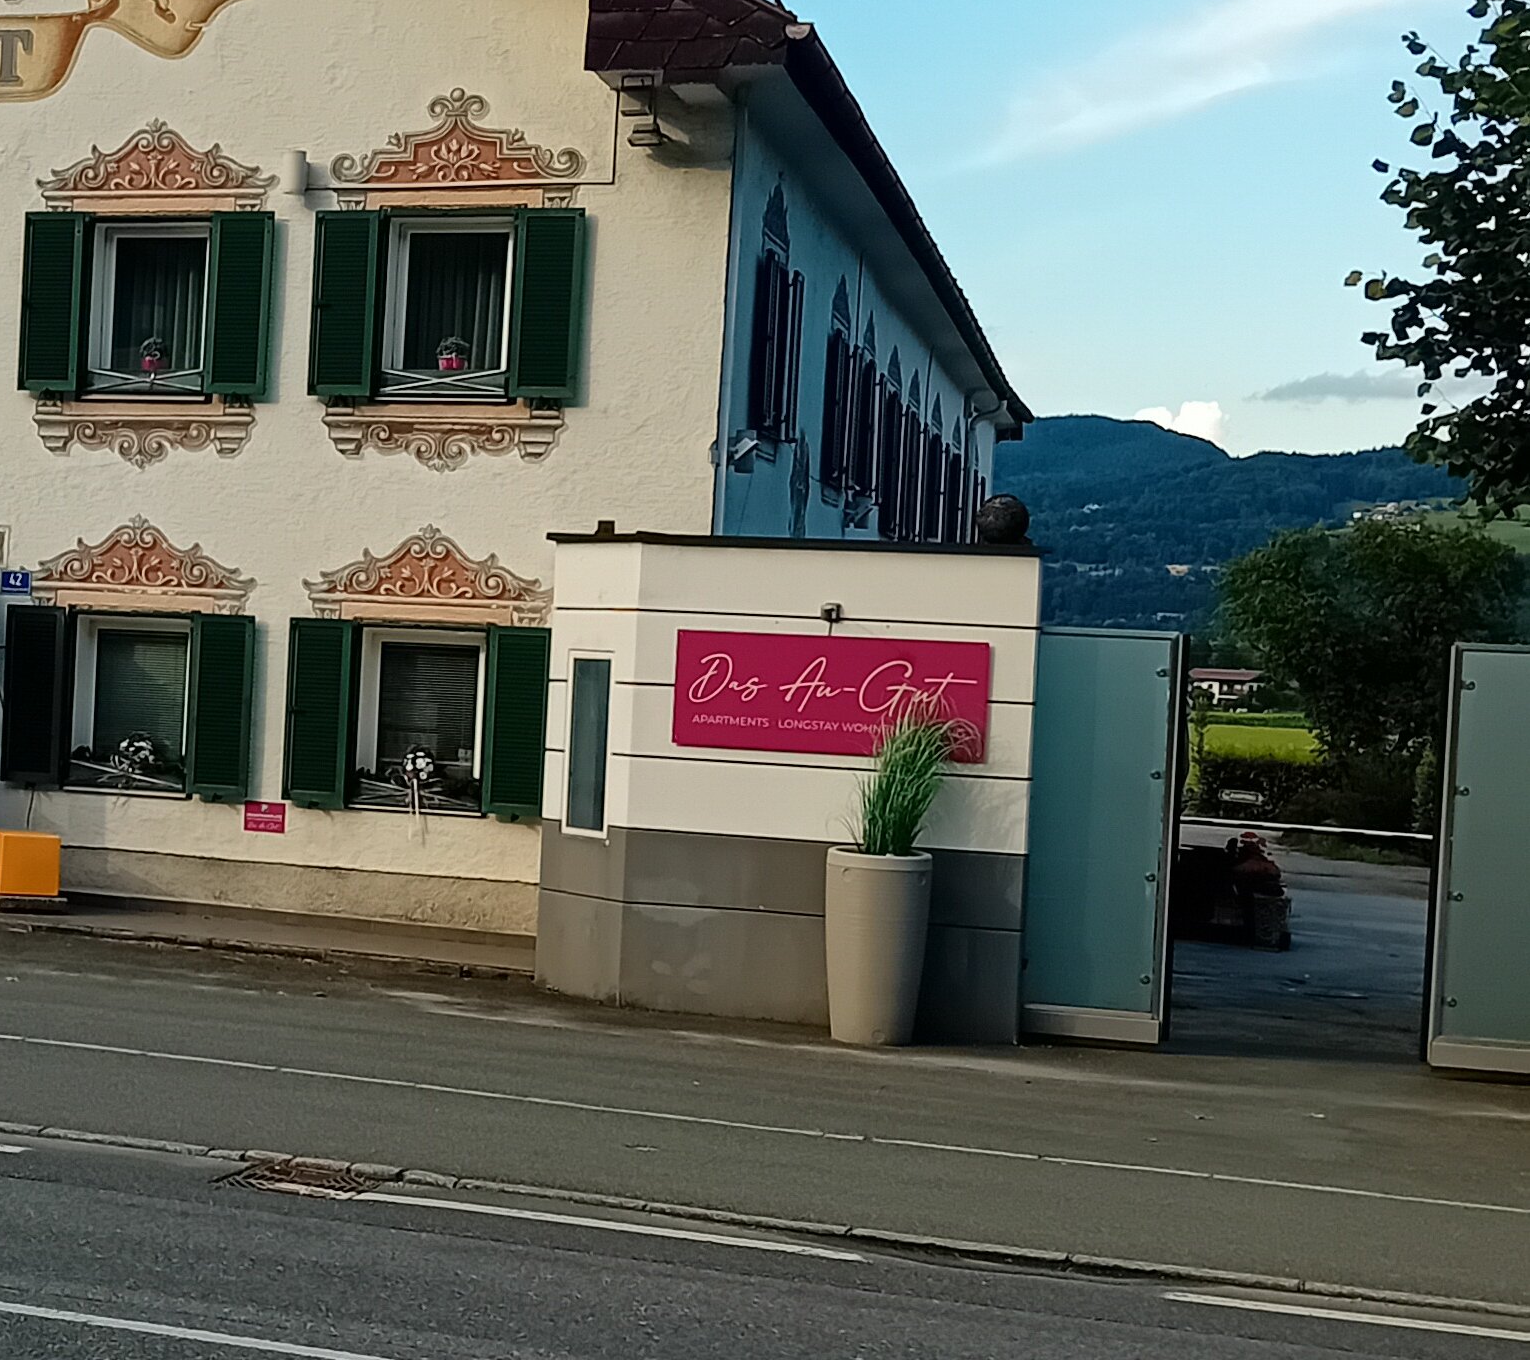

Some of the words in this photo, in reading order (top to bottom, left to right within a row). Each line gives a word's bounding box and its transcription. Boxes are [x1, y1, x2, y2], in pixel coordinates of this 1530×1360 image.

[9, 572, 22, 586] 42
[688, 653, 768, 703] Das
[779, 656, 979, 717] Au-Gut
[692, 714, 770, 728] APARTMENTS
[777, 719, 840, 731] LONGSTAY
